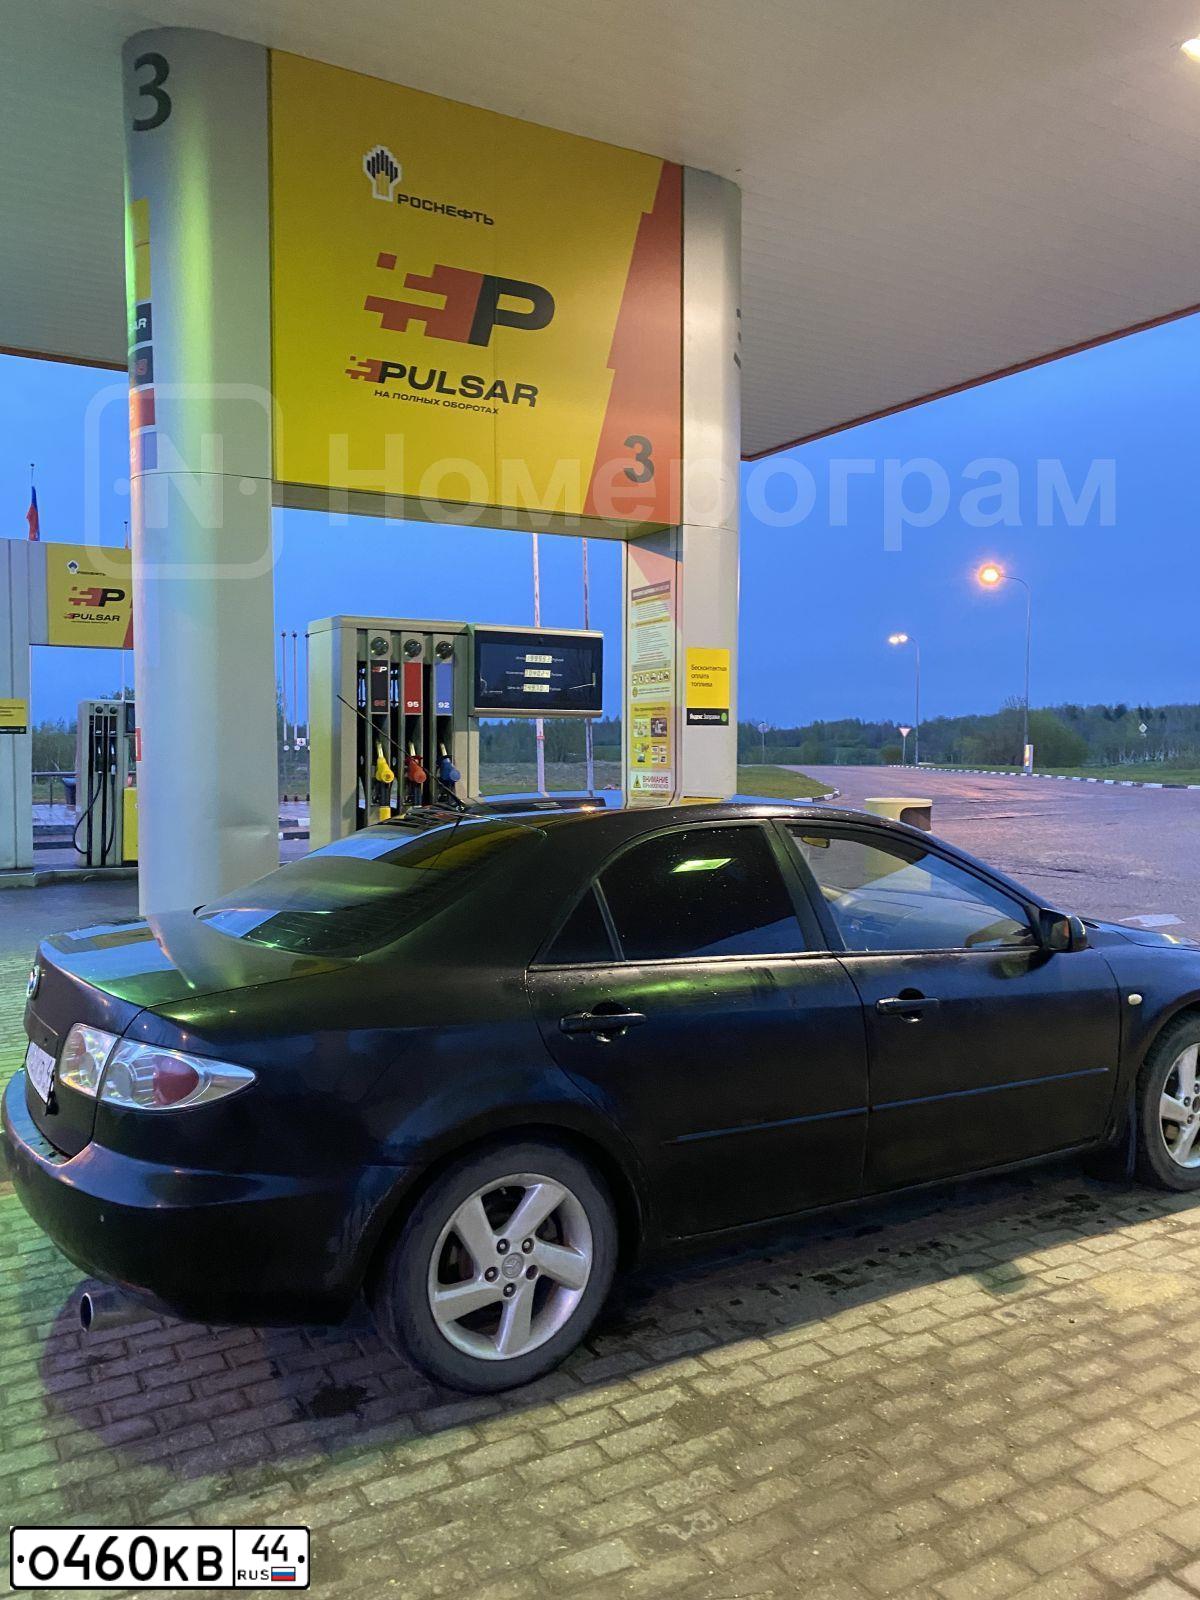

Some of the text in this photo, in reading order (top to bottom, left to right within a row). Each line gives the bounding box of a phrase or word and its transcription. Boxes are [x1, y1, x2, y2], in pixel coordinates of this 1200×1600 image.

[132, 52, 172, 131] 3
[397, 193, 495, 226] РОСНЕФТЬ
[467, 274, 556, 348] P
[374, 389, 500, 415] НА ПОЛНЫХ ОБОРОТАХ
[378, 360, 540, 408] PULSAR
[623, 434, 655, 484] 3
[72, 612, 121, 622] PULSAR
